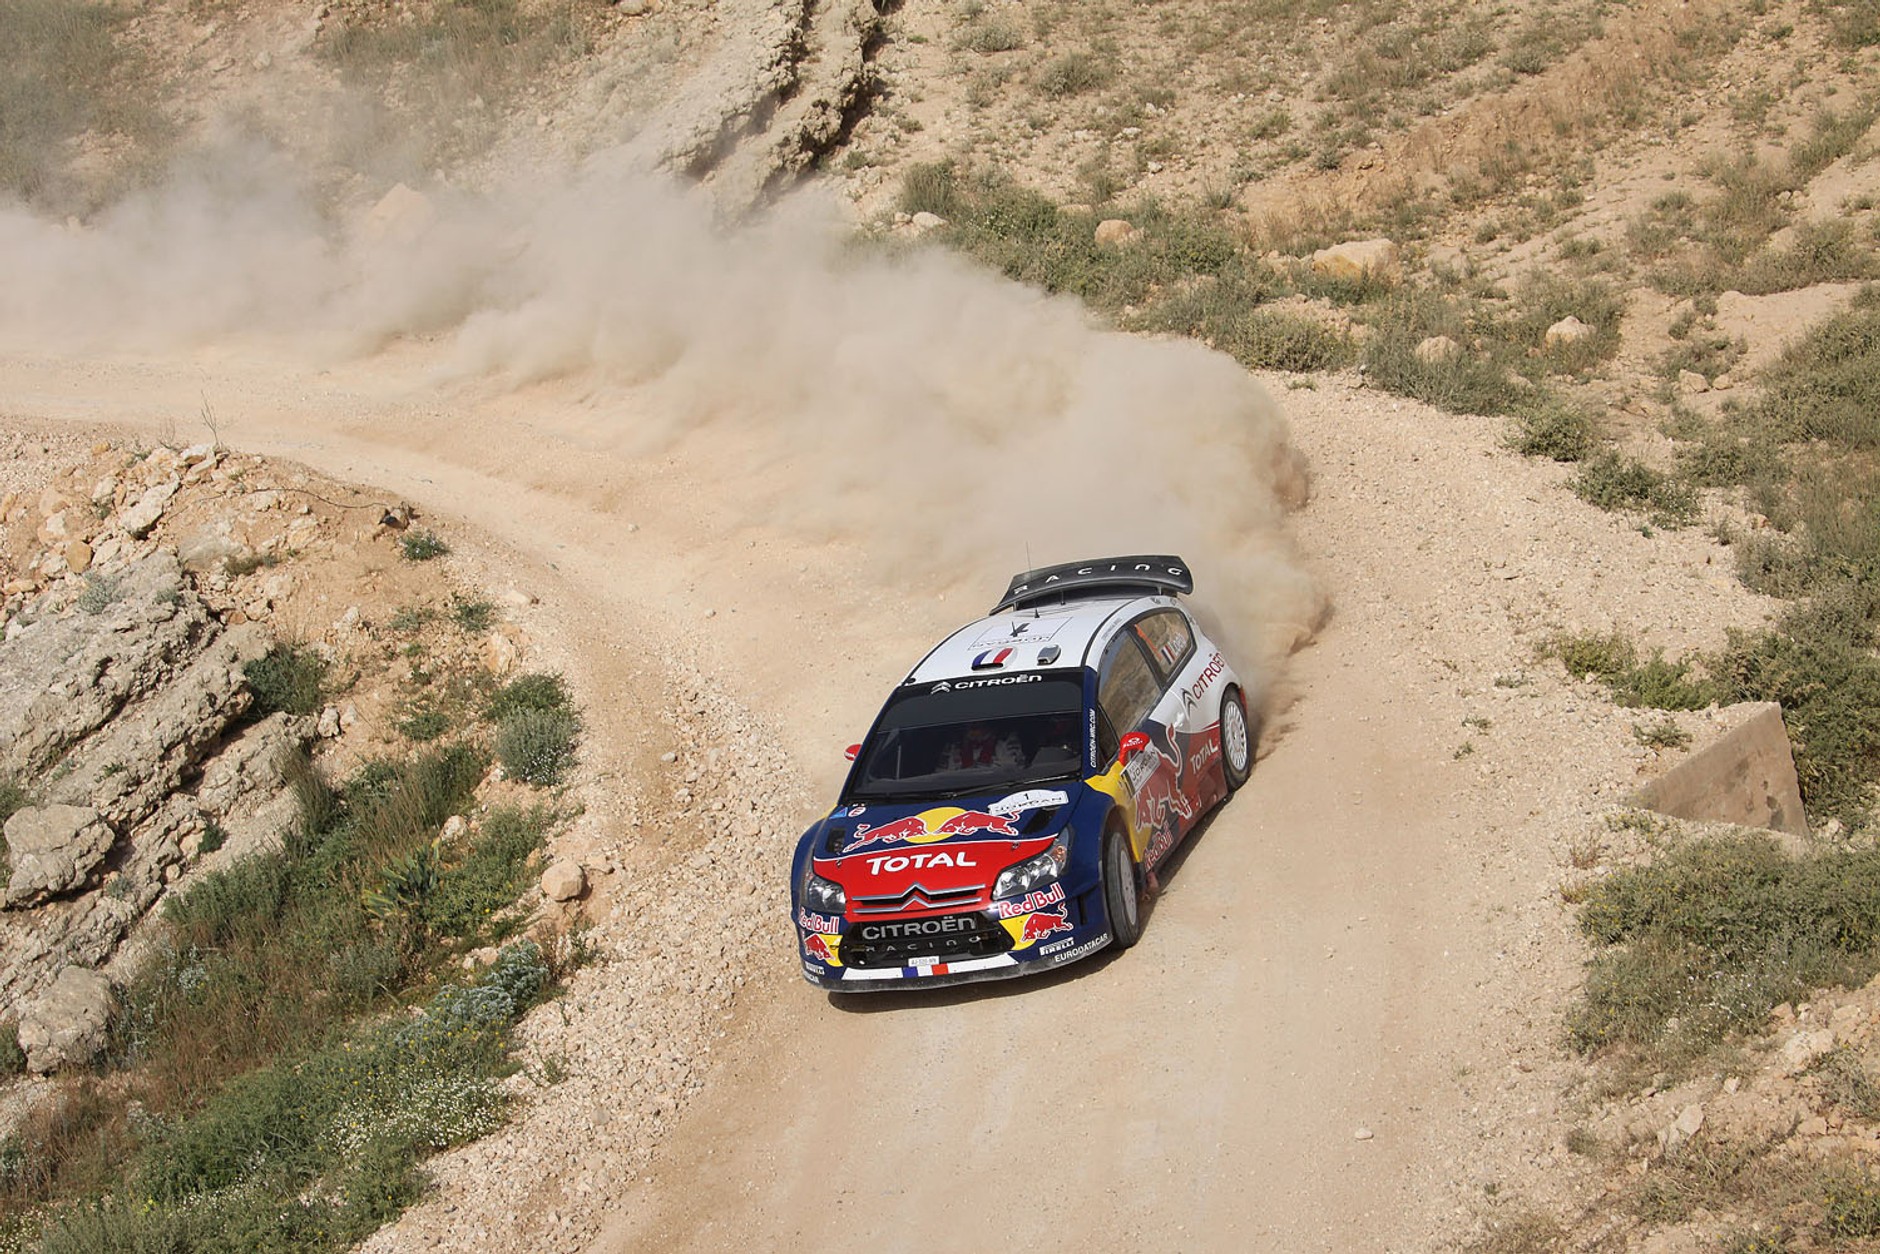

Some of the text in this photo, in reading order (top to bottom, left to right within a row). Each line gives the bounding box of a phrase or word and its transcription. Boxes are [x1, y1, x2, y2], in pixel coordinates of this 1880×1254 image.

[1013, 563, 1183, 595] RACING
[954, 673, 1042, 690] CITROËN
[1189, 738, 1219, 775] TOTAL
[866, 851, 977, 876] TOTAL
[998, 881, 1066, 919] Red Bull
[813, 914, 840, 934] Bull
[862, 915, 976, 940] CITROËN
[1055, 933, 1108, 963] EURODATACAR
